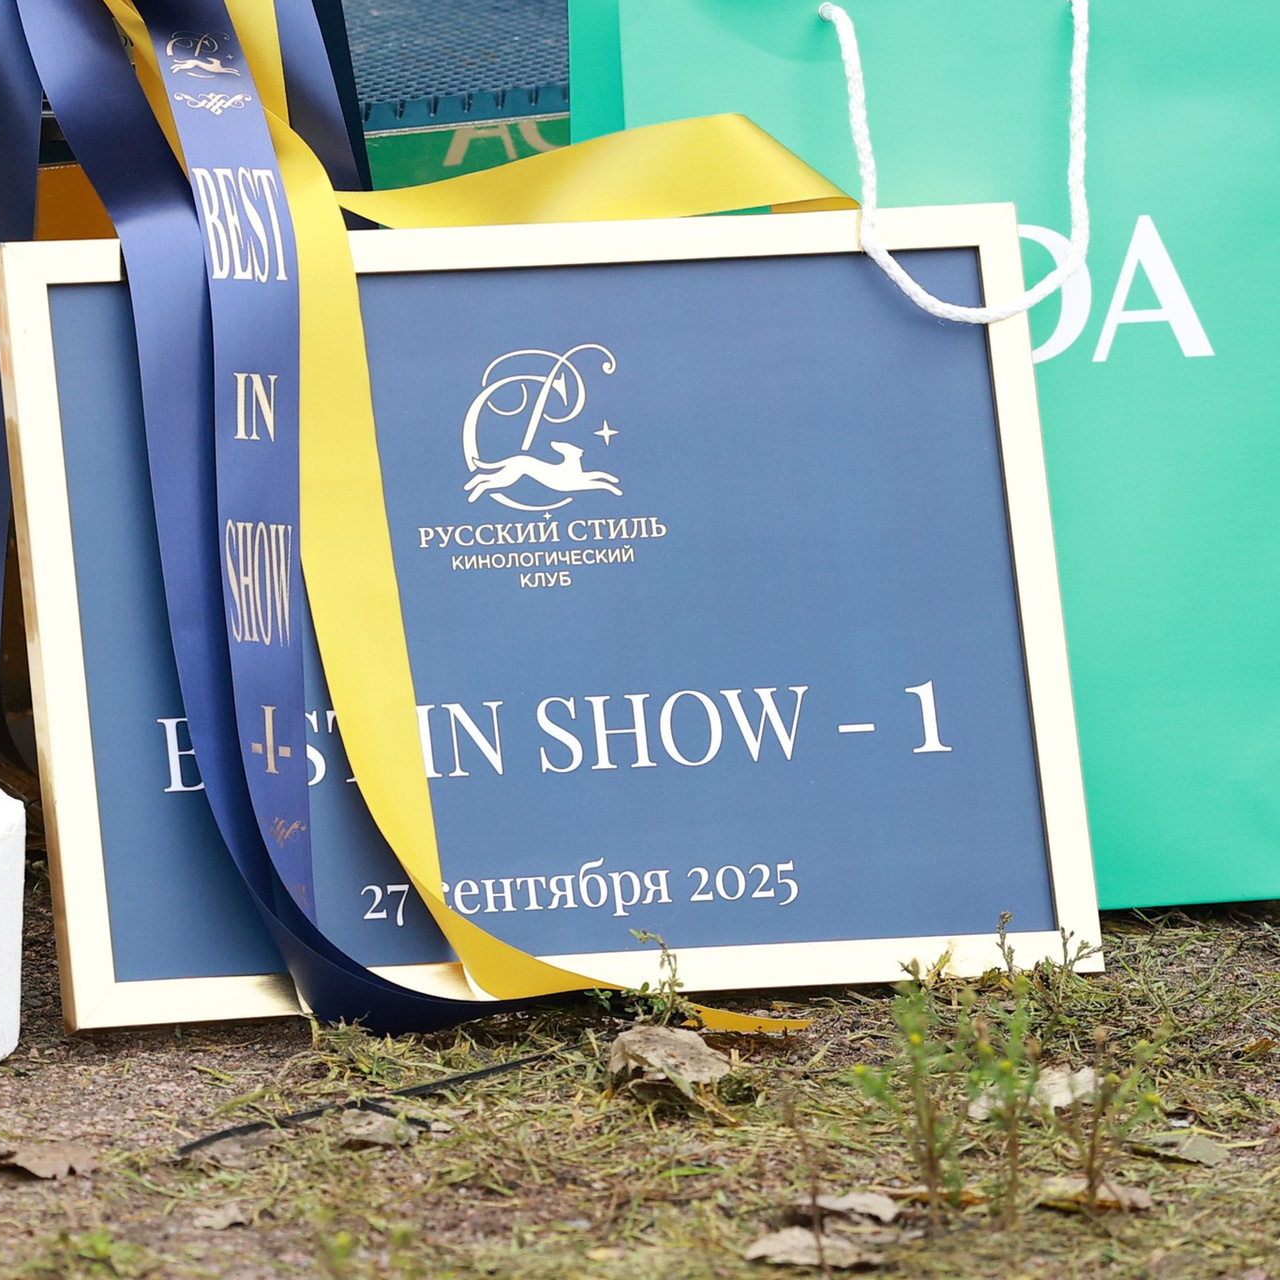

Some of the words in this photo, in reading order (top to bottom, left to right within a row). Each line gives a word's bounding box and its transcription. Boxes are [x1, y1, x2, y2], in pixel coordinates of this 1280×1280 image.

[191, 166, 288, 282] BEST
[233, 372, 278, 443] IN
[418, 518, 560, 548] РУССКИЙ
[567, 517, 668, 541] СТИЛЬ
[451, 545, 635, 570] КИНОЛОГИЧЕСКИЙ
[225, 519, 292, 647] SHOW
[519, 571, 572, 588] КЛУБ
[418, 700, 504, 778] IN
[535, 685, 809, 773] SHOW
[905, 680, 953, 754] 1
[360, 883, 410, 927] 27
[686, 859, 800, 907] 2025
